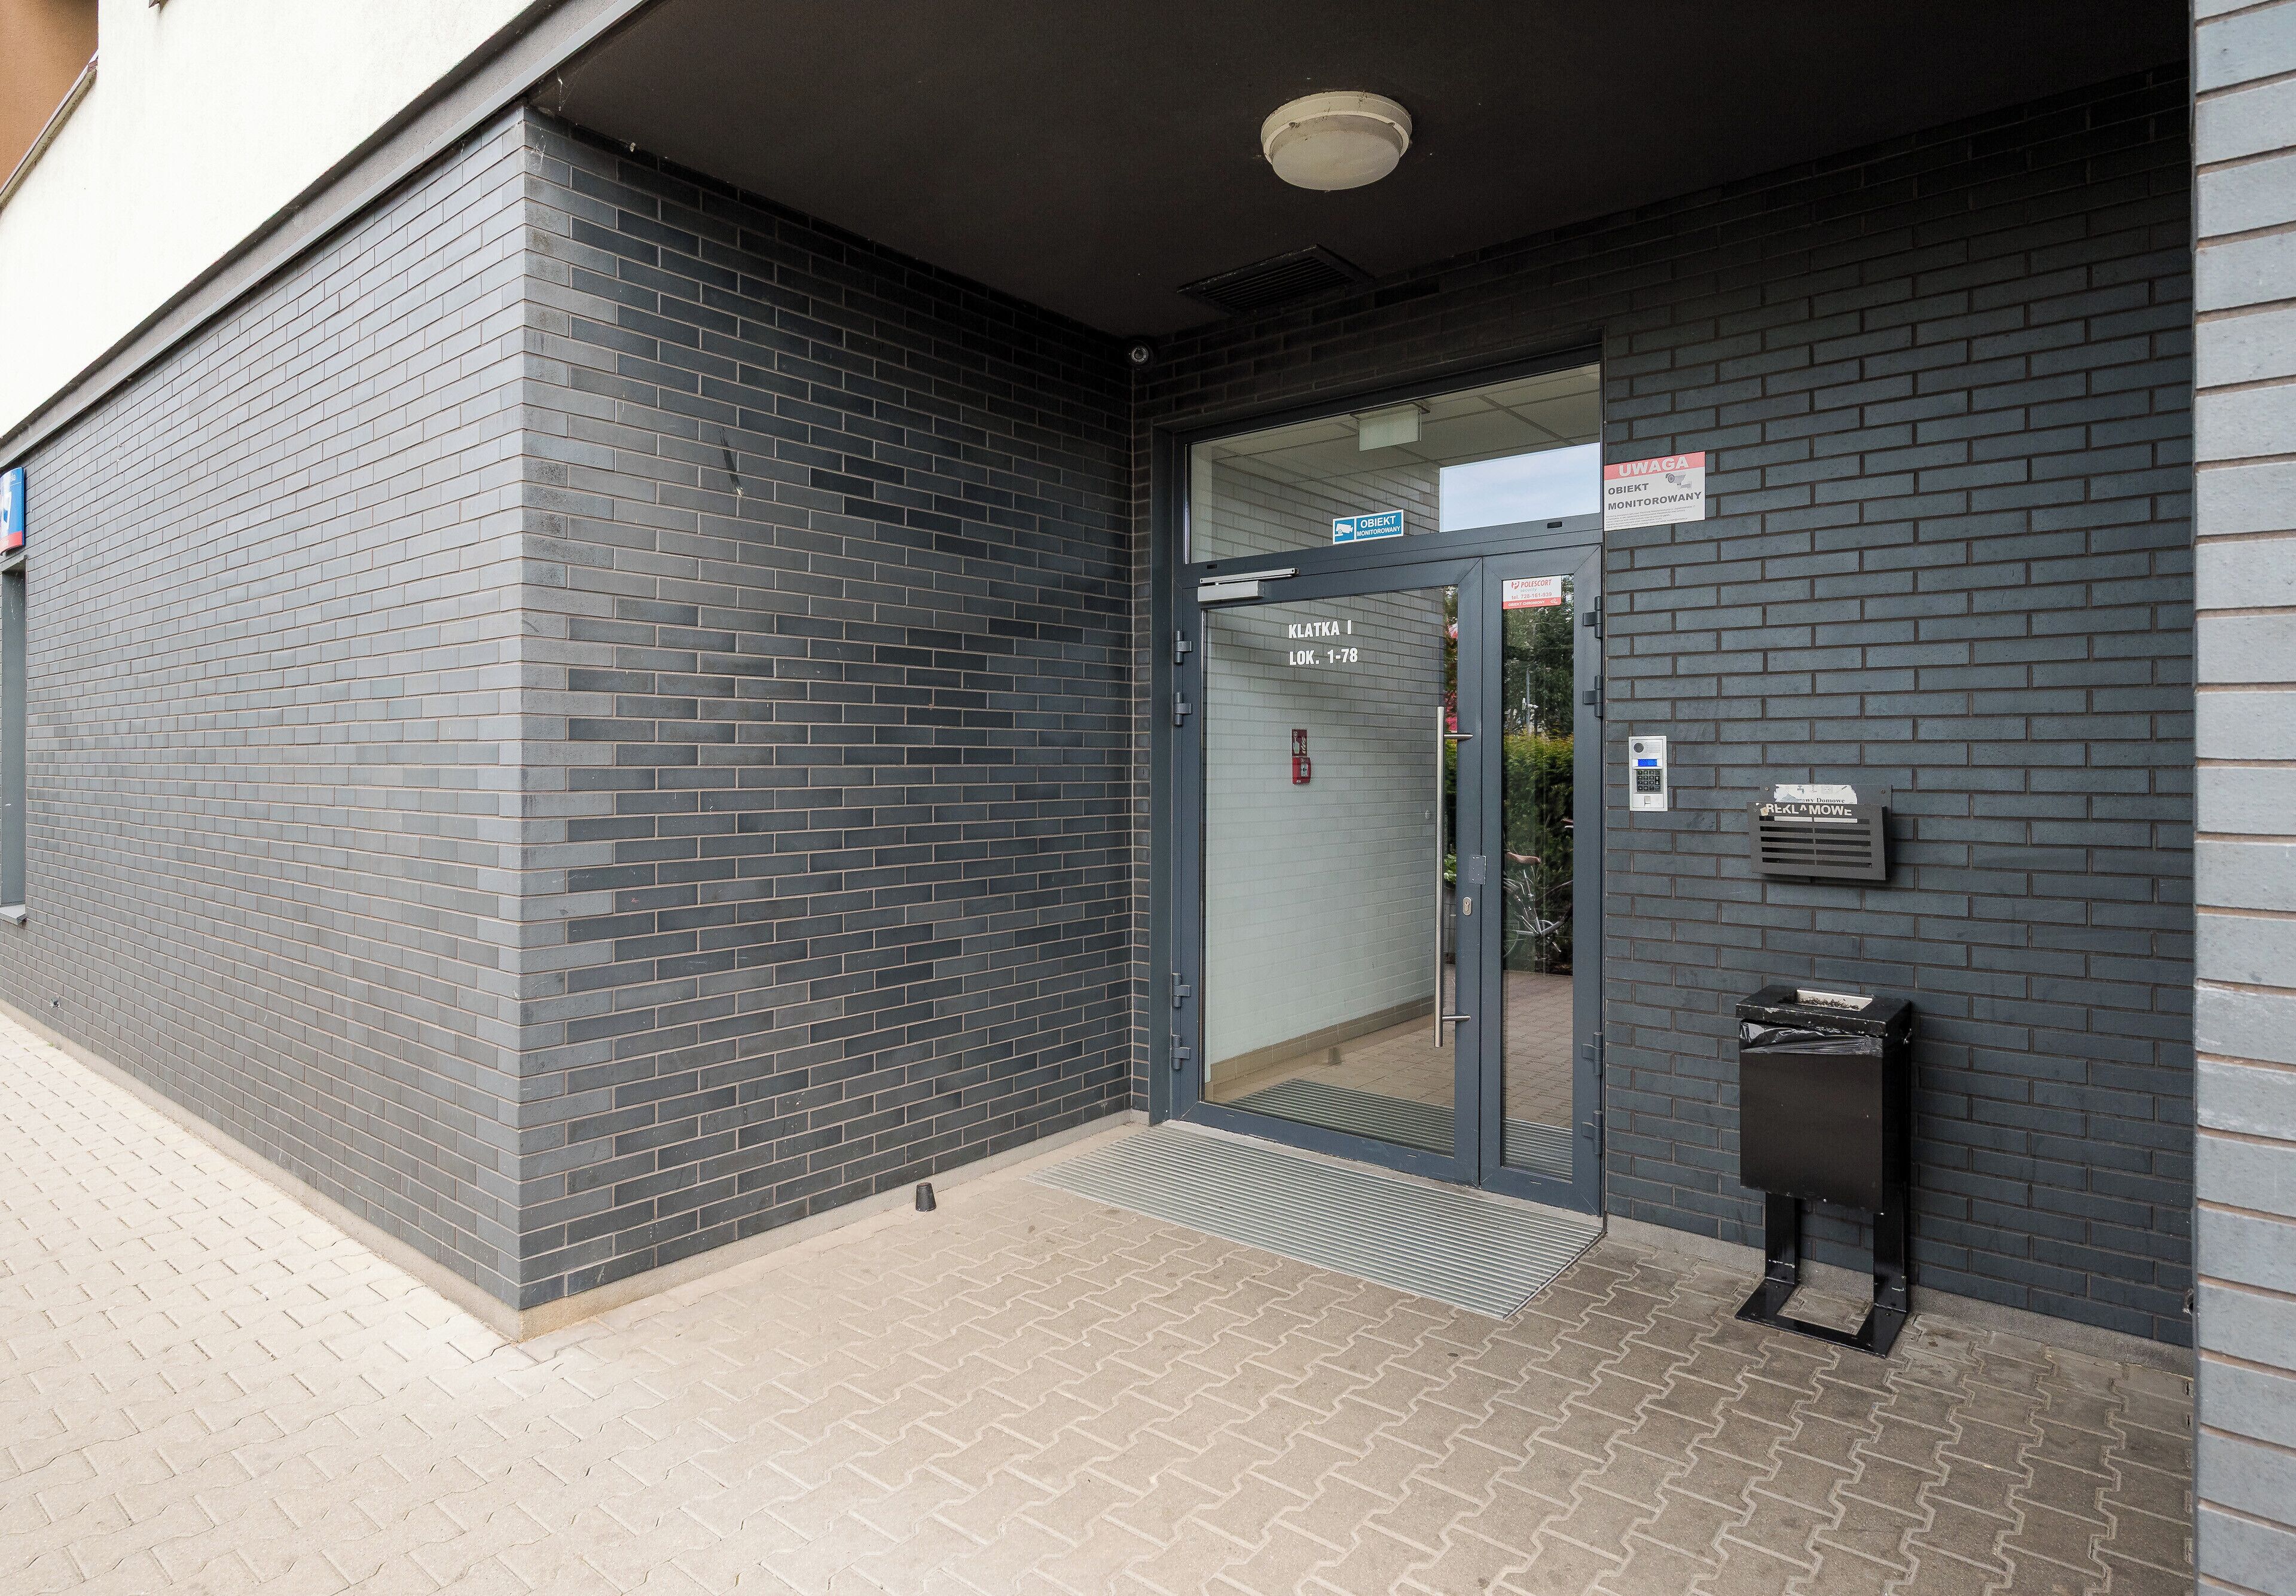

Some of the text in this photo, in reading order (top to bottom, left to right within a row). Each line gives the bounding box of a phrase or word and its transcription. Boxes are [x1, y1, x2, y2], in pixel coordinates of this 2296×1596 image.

[1619, 456, 1689, 477] UWAGA
[1608, 483, 1648, 495] OBIEKT
[1608, 491, 1702, 510] MONITOROWANY
[1360, 515, 1396, 528] OBIEKT
[1357, 525, 1400, 537] MONITOROWANY
[1521, 579, 1552, 588] POLESCORT
[1289, 620, 1340, 639] KLATKA
[1289, 647, 1358, 665] LOK. 1-78
